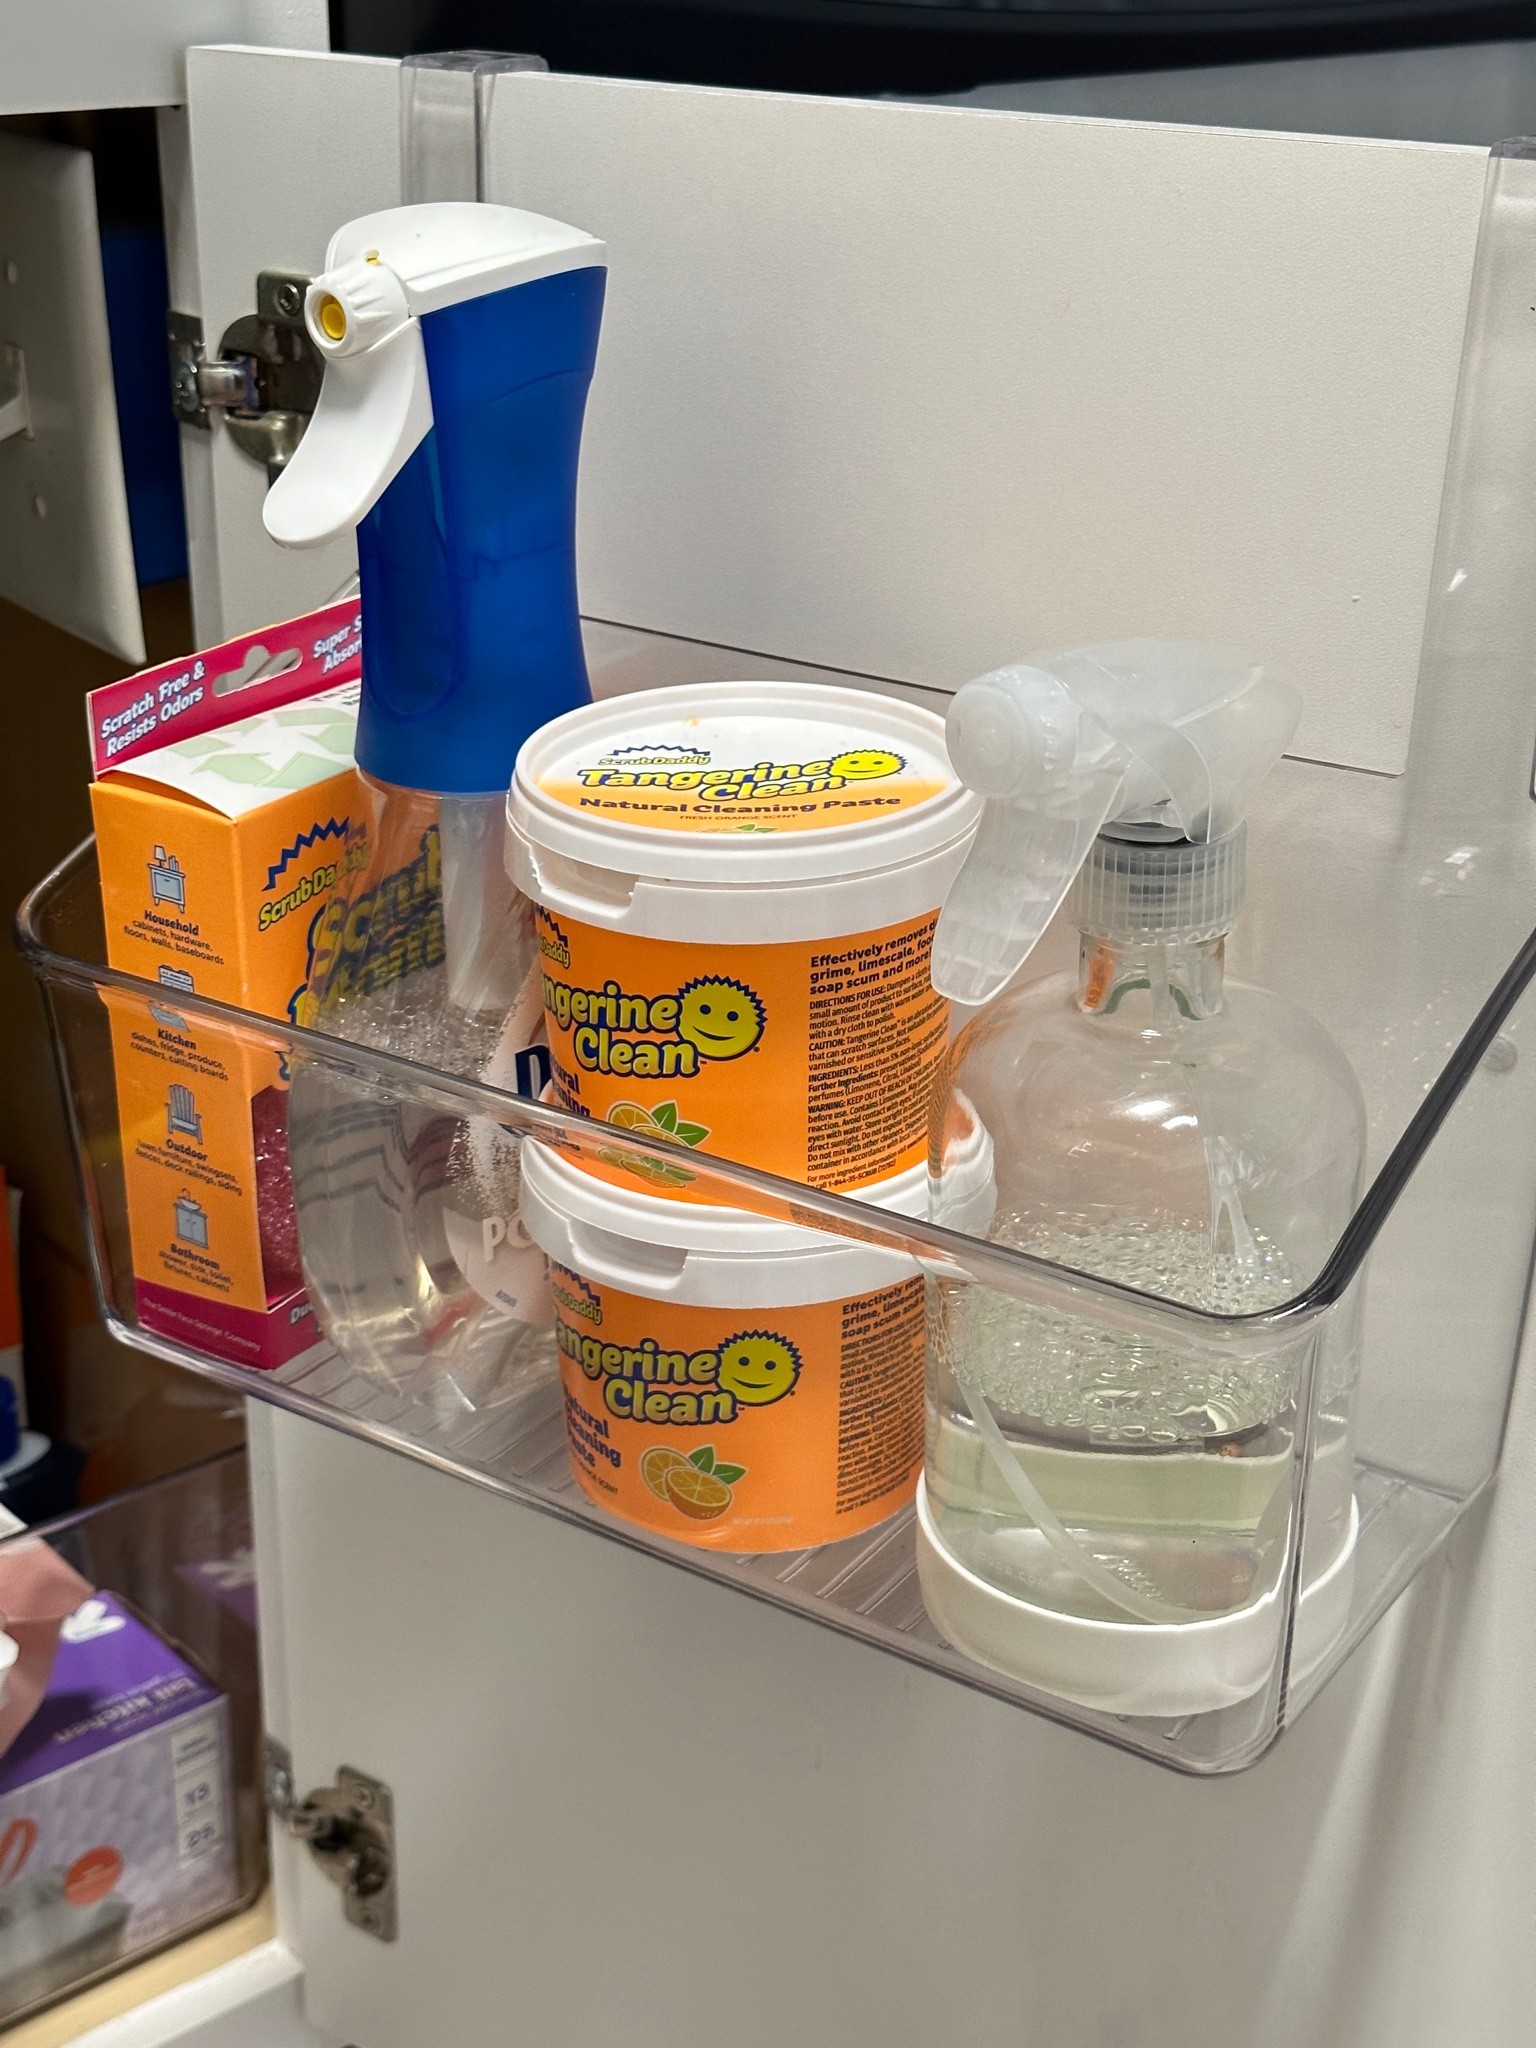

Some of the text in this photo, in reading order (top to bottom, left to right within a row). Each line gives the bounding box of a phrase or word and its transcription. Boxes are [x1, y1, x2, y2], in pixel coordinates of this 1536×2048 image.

[313, 625, 352, 659] Super
[322, 634, 362, 674] Absor
[101, 660, 206, 738] Scratch Free &
[107, 686, 204, 757] Resists Odors
[578, 760, 833, 790] Tangerine
[699, 776, 847, 801] Clean
[580, 796, 900, 814] Natural Cleaning Paste
[132, 918, 213, 952] cabinets, hardware,
[144, 909, 199, 936] Household
[124, 925, 150, 943] floors,
[175, 944, 225, 965] baseboards
[811, 944, 883, 968] Effectively
[884, 925, 928, 951] removes
[810, 947, 915, 984] grime, limescale,
[810, 981, 843, 995] soap
[846, 973, 880, 988] scum
[882, 962, 903, 978] and
[542, 975, 683, 1034] ngerine
[809, 993, 856, 1010] DIRECTIONS
[856, 990, 871, 1001] FOR
[871, 985, 886, 997] USE:
[886, 976, 911, 992] Dampen
[809, 1008, 831, 1020] small
[831, 1003, 861, 1016] amount
[861, 999, 870, 1009] of
[869, 992, 895, 1009] product
[895, 990, 903, 998] to
[809, 1018, 840, 1030] motion.
[841, 1013, 861, 1025] Rinse
[861, 1008, 880, 1019] clean
[880, 1002, 895, 1013] with
[809, 1029, 826, 1040] with
[833, 1027, 847, 1036] dry
[847, 1021, 866, 1033] cloth
[866, 1020, 874, 1028] to
[874, 1012, 896, 1027] polish.
[157, 1028, 197, 1050] Kitchen
[573, 1025, 700, 1079] Clean
[809, 1029, 880, 1052] CAUTION: Tangerine
[809, 1051, 825, 1061] that
[826, 1050, 840, 1059] can
[841, 1043, 867, 1056] scratch
[867, 1033, 896, 1049] surfaces.
[188, 1052, 226, 1070] produce,
[808, 1056, 846, 1071] varnished
[847, 1055, 856, 1064] or
[856, 1046, 886, 1062] sensitive
[808, 1065, 860, 1083] INGREDIENTS:
[859, 1061, 875, 1072] Less
[875, 1056, 890, 1067] than
[200, 1065, 229, 1081] boards
[808, 1081, 838, 1093] Further
[808, 1089, 845, 1105] perfumes
[808, 1099, 846, 1114] WARNING:
[846, 1094, 864, 1106] KEEP
[864, 1090, 879, 1101] OUT
[879, 1086, 887, 1096] OF
[808, 1112, 833, 1124] before
[834, 1110, 849, 1119] use.
[849, 1100, 879, 1115] Contains
[808, 1121, 841, 1133] reaction.
[842, 1114, 861, 1126] Avoid
[862, 1106, 886, 1121] contact
[807, 1134, 826, 1145] eyes
[826, 1129, 842, 1139] with
[865, 1119, 882, 1130] Store
[807, 1142, 830, 1153] direct
[861, 1132, 871, 1140] Do
[872, 1127, 882, 1137] not
[166, 1138, 208, 1161] Outdoor
[807, 1153, 819, 1162] Do
[819, 1150, 832, 1160] not
[833, 1147, 846, 1157] mix
[847, 1143, 862, 1154] with
[862, 1138, 880, 1149] other
[807, 1158, 843, 1172] container
[843, 1156, 850, 1164] in
[850, 1145, 886, 1163] accordance
[807, 1175, 818, 1183] For
[819, 1172, 836, 1181] more
[837, 1163, 867, 1177] ingredient
[171, 1243, 220, 1270] Bathroom
[842, 1286, 904, 1315] Effectively
[841, 1297, 920, 1339] soap scum and
[842, 1310, 881, 1330] grime,
[554, 1316, 722, 1381] angerine
[603, 1375, 739, 1426] Clean
